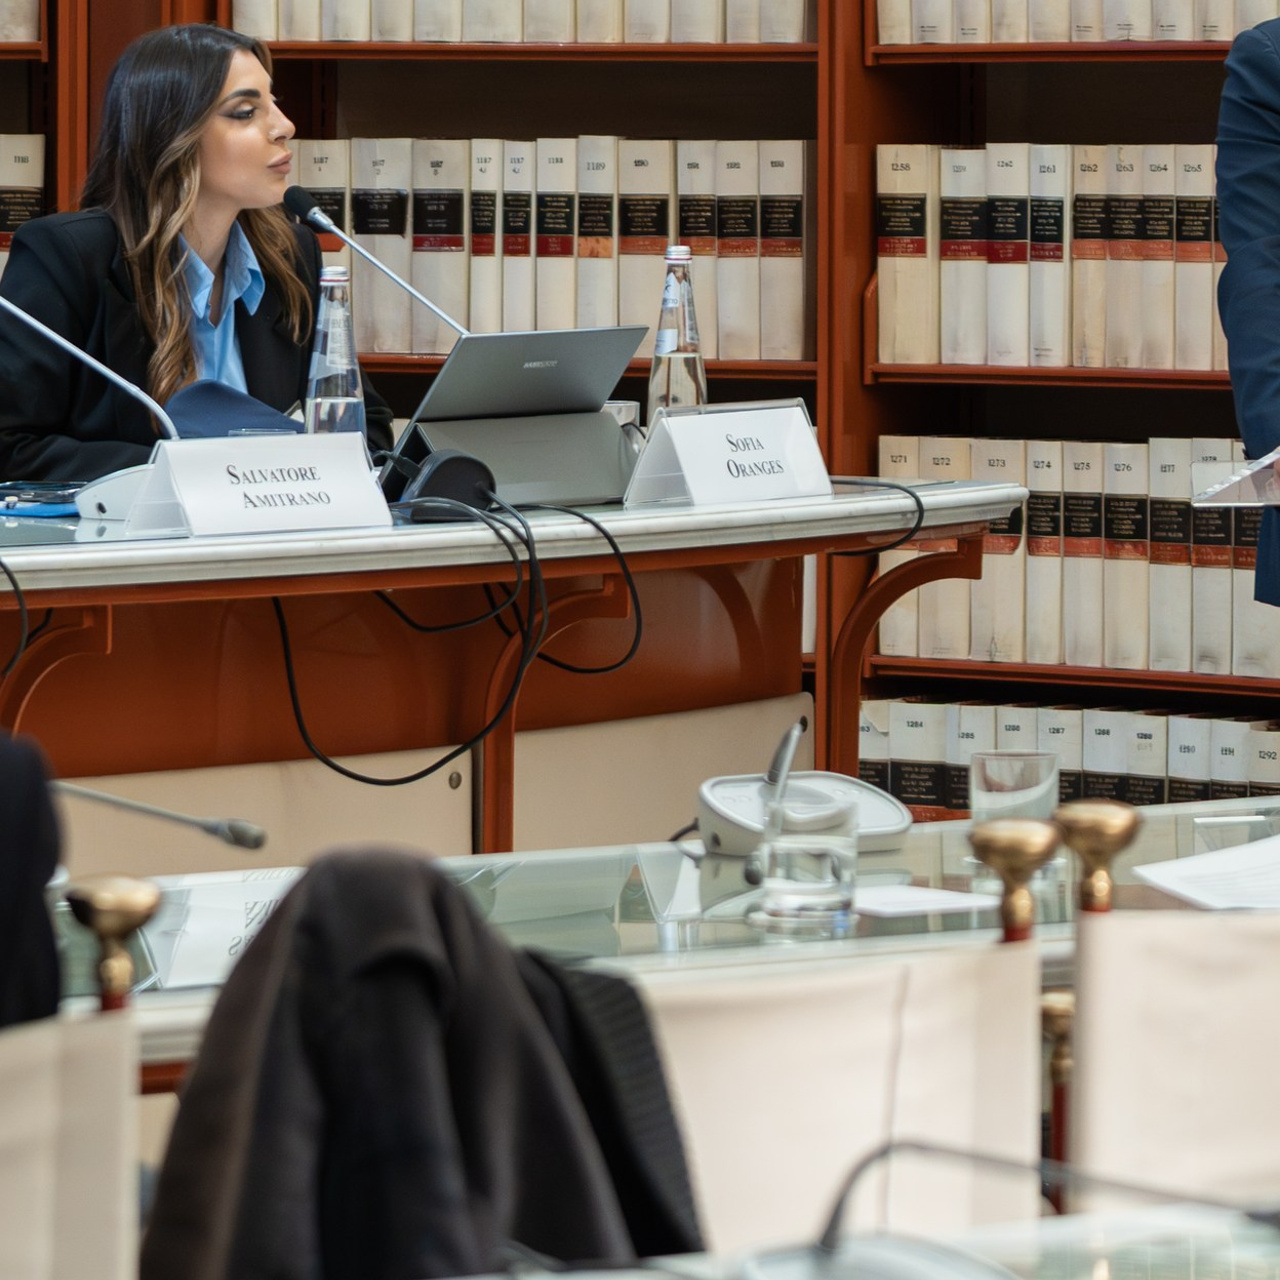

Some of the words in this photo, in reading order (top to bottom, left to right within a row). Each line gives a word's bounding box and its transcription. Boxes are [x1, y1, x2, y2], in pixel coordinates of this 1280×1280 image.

[892, 163, 910, 171] 1258
[1040, 165, 1056, 173] 1261
[1080, 164, 1098, 172] 1262
[1116, 164, 1134, 172] 1263
[1150, 164, 1168, 172] 1264
[1184, 164, 1202, 172] 1265
[891, 455, 907, 463] 1271
[988, 459, 1005, 467] 1273
[1074, 462, 1090, 470] 1275
